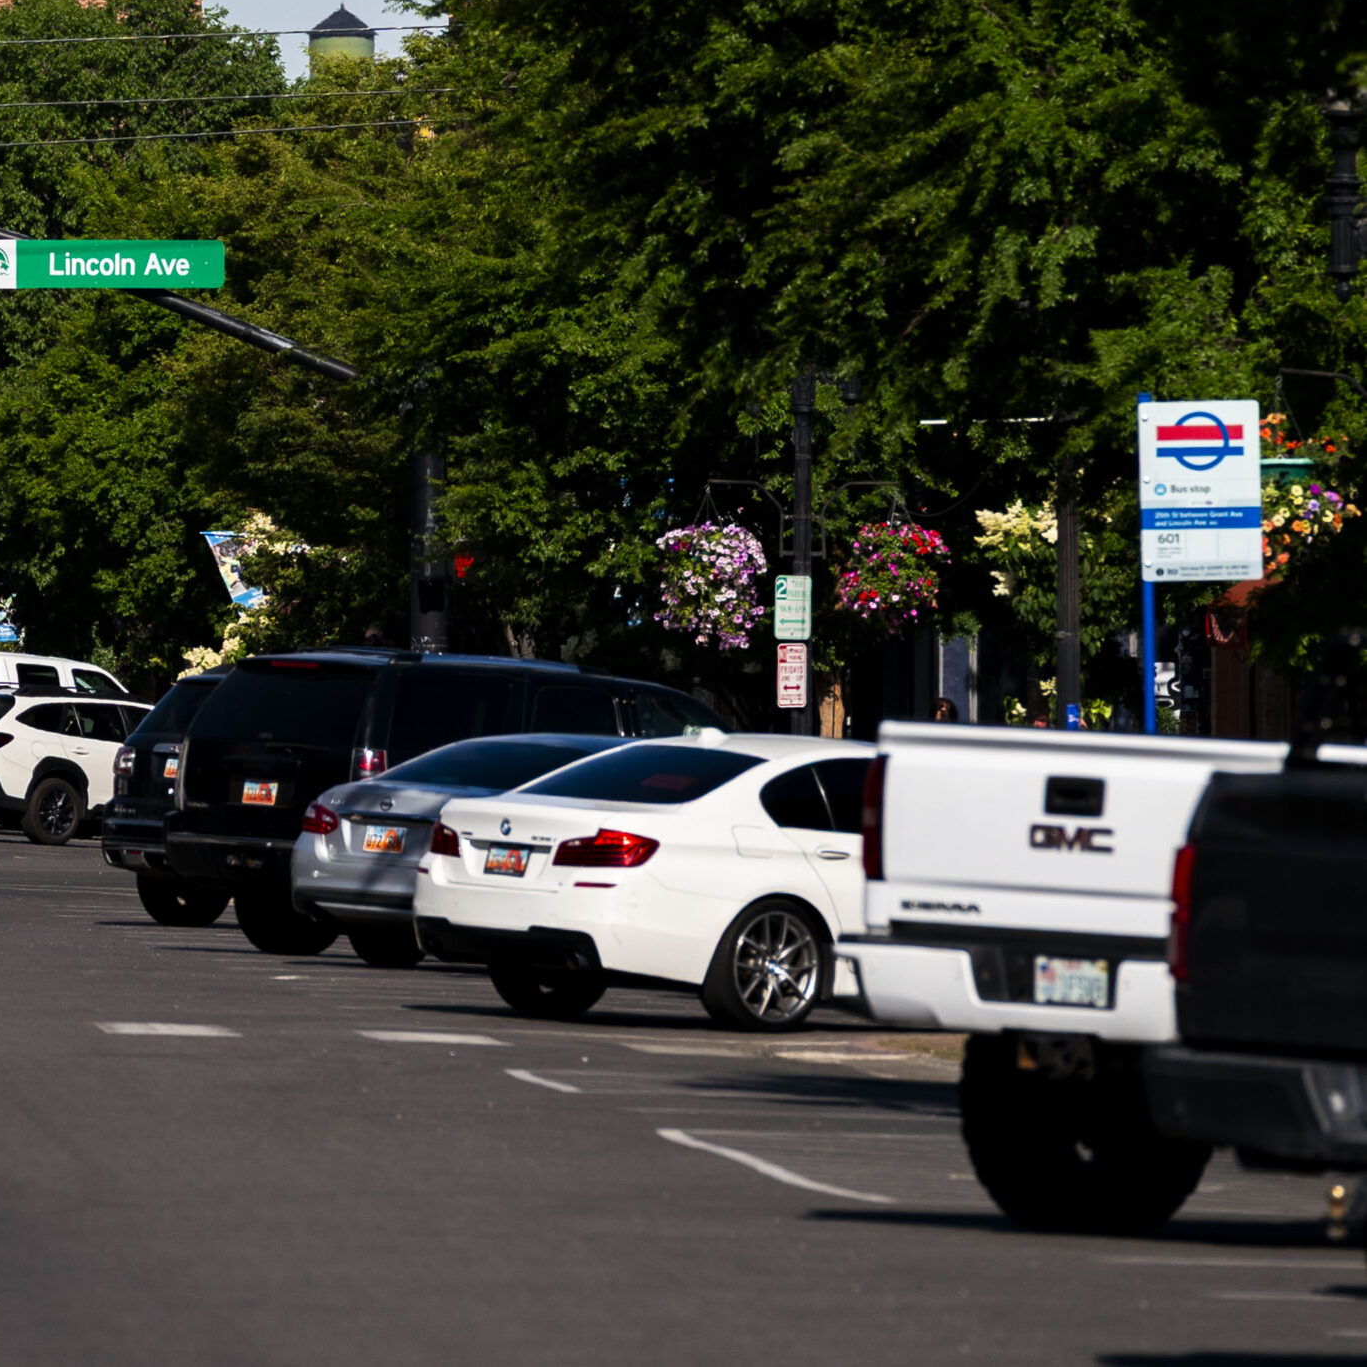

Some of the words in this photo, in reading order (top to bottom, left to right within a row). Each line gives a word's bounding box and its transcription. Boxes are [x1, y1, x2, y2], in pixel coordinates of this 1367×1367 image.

[49, 252, 136, 276] Lincoln
[143, 252, 190, 276] Ave
[1170, 485, 1187, 493] Bus
[1190, 484, 1210, 494] stop
[1158, 534, 1179, 544] 601
[776, 579, 787, 598] 2
[1030, 824, 1115, 854] GMC
